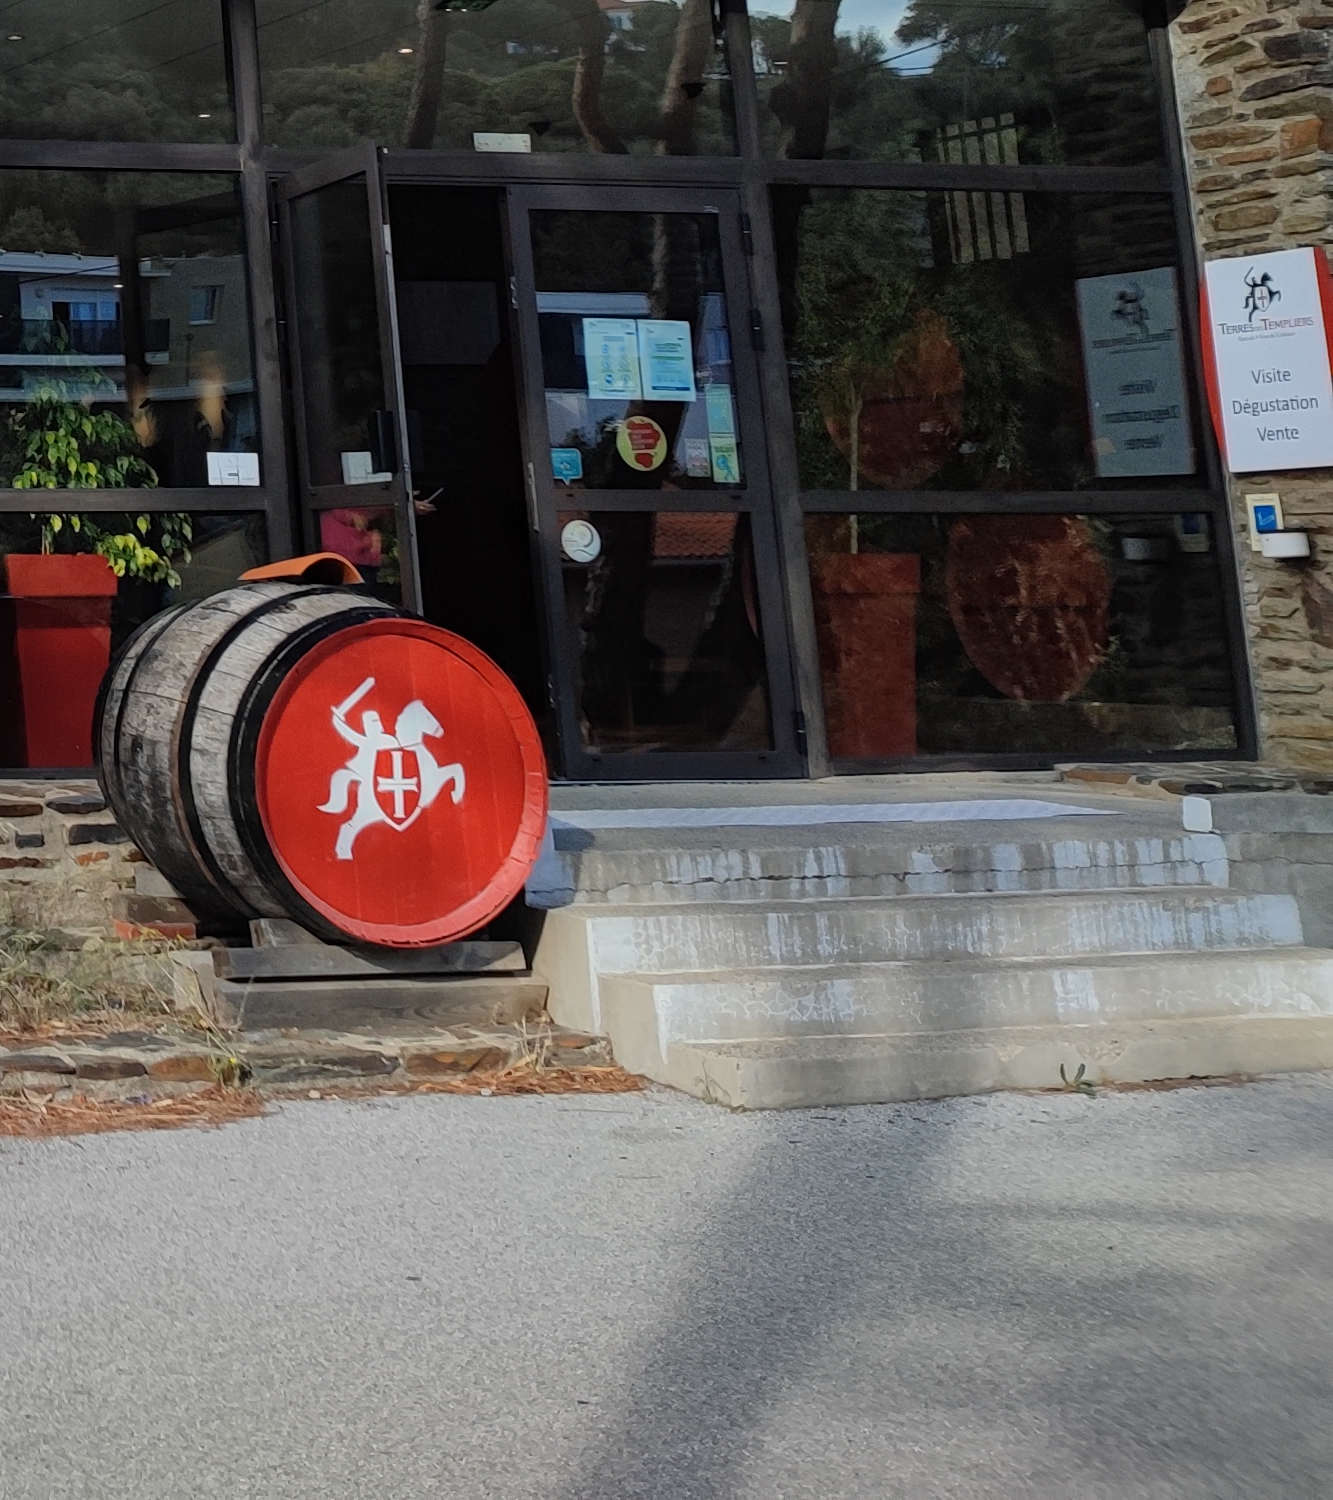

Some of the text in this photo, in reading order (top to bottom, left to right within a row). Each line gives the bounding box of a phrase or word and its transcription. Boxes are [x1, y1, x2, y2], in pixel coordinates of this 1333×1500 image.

[1251, 368, 1292, 384] Visite
[1232, 395, 1319, 417] Dégustation
[1257, 426, 1300, 442] Vente
